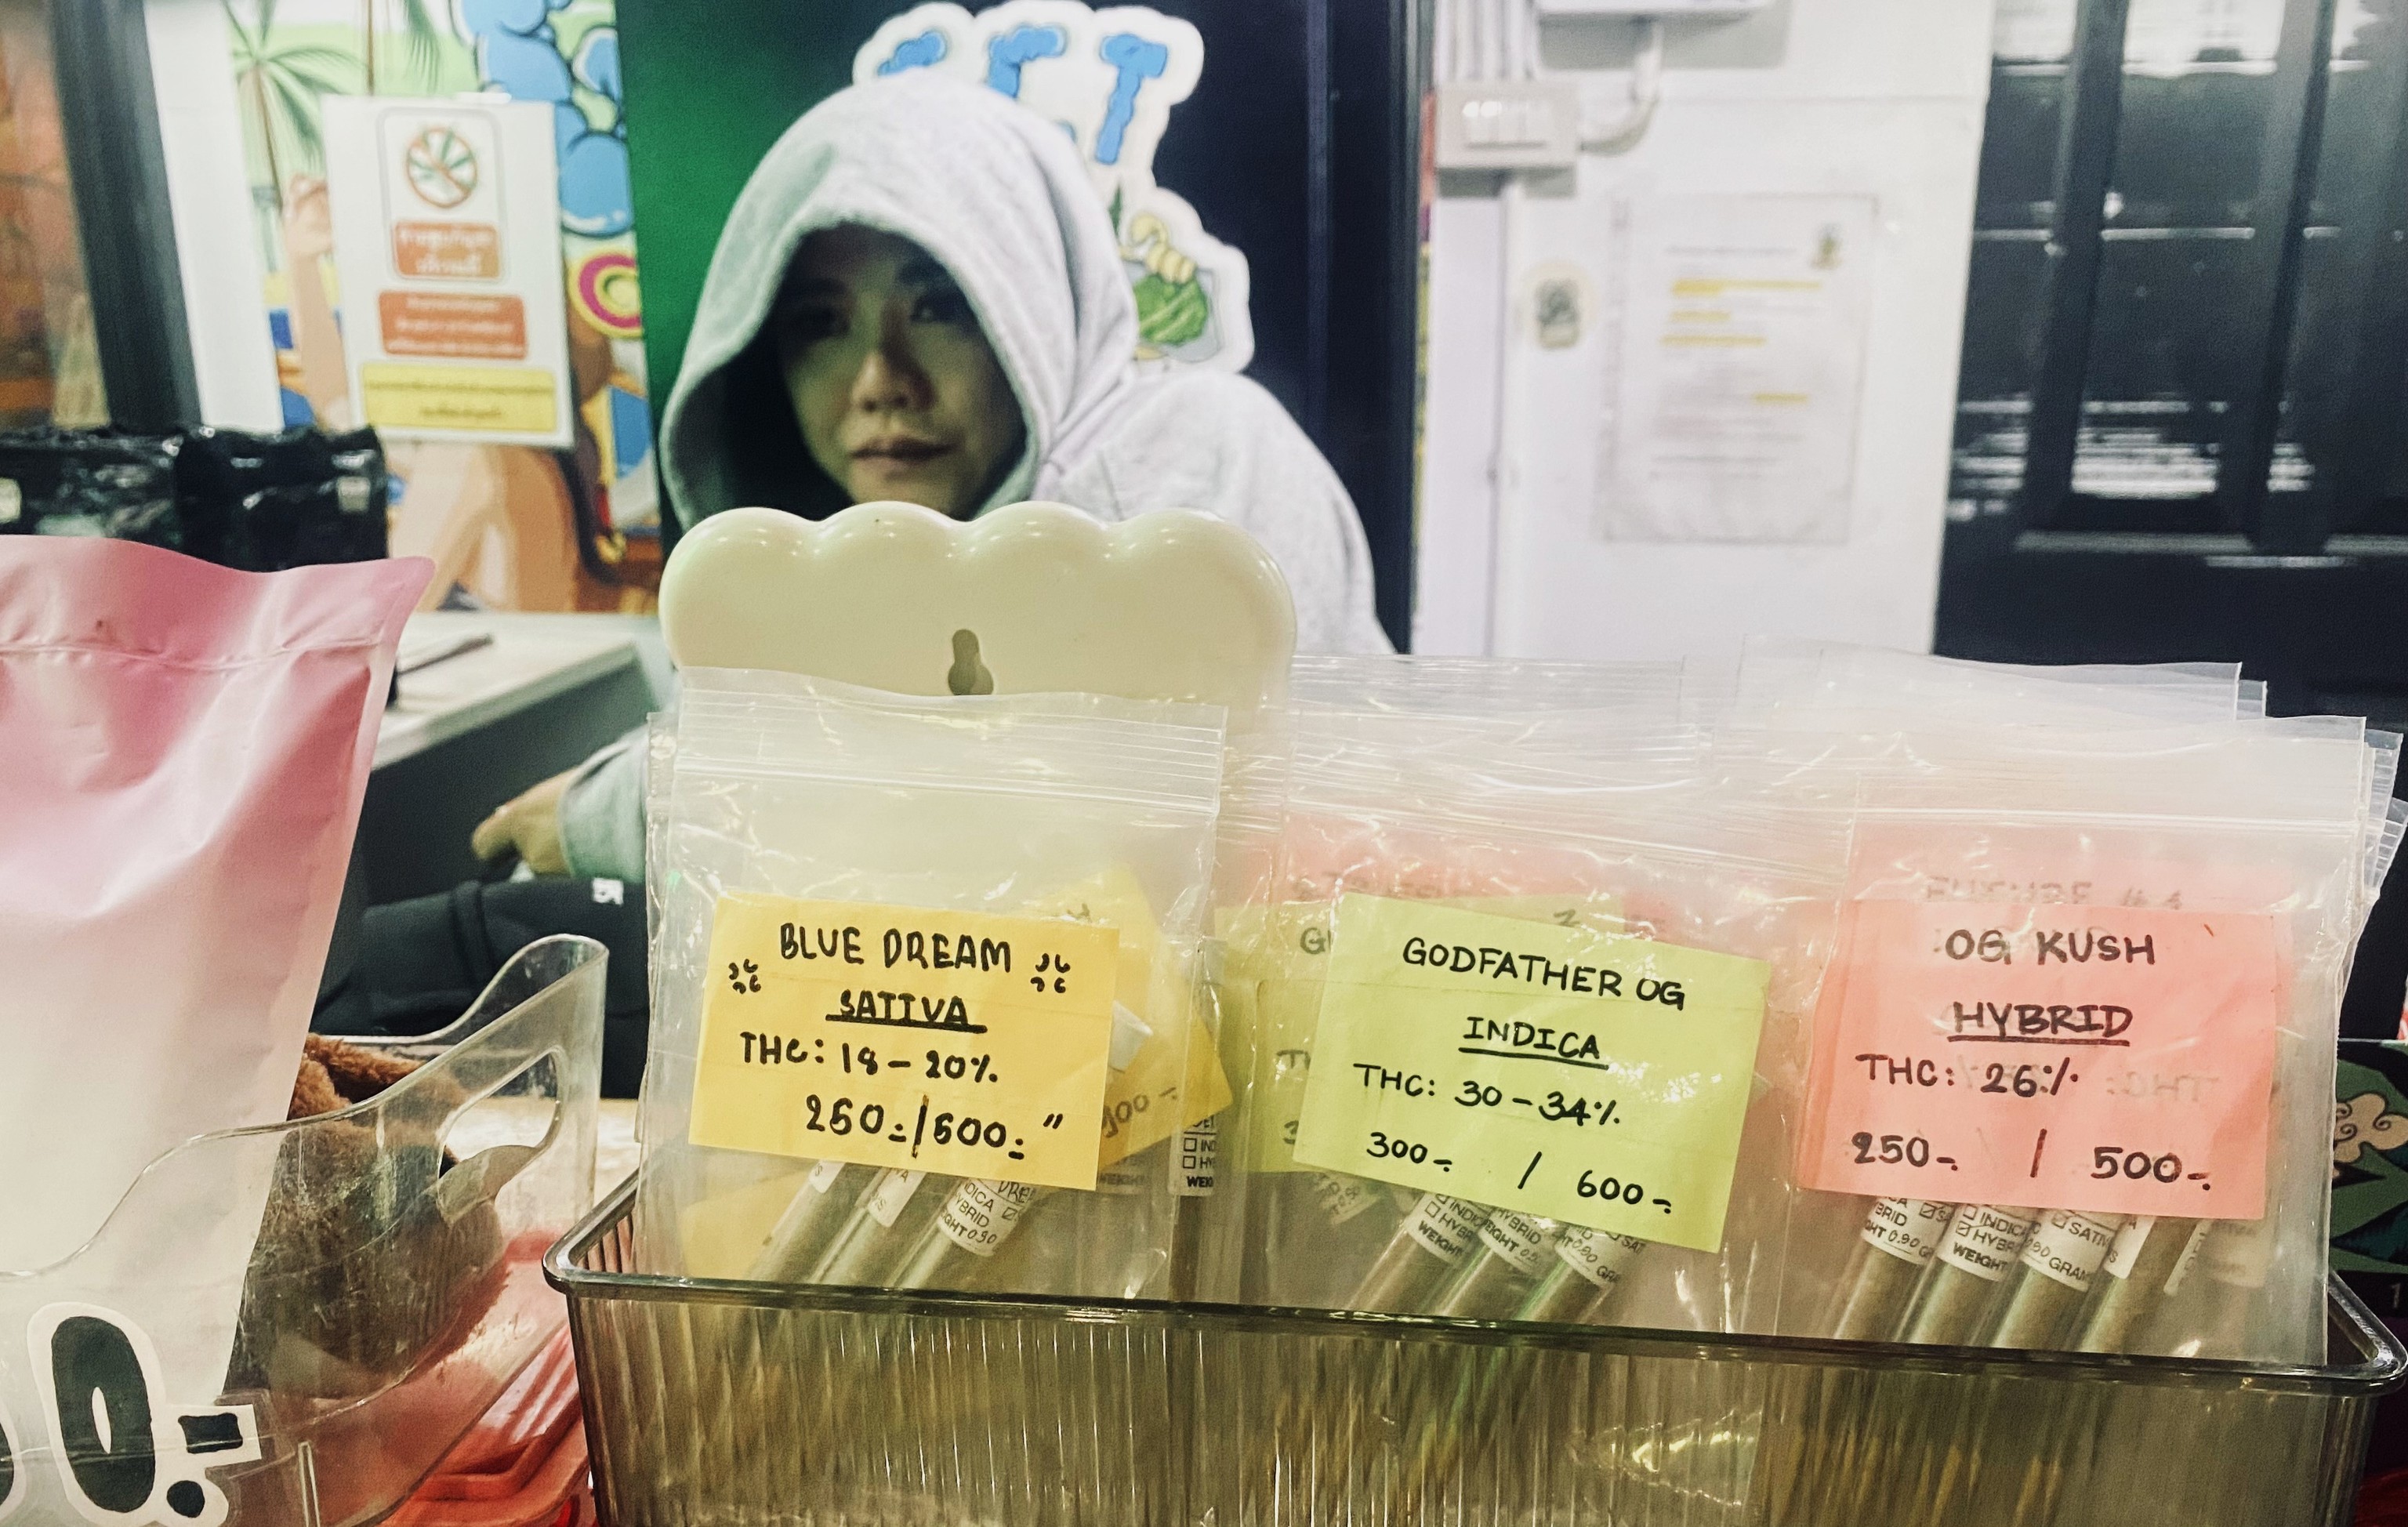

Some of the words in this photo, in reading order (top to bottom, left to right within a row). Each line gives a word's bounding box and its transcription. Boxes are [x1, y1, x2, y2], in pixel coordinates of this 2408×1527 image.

[781, 923, 864, 964] BLUE
[883, 928, 1011, 973] DREAM
[1945, 930, 2011, 965] OG
[2036, 930, 2155, 965] KUSH
[1402, 937, 1622, 998] GODFATHER
[1636, 977, 1685, 1011] OG
[1953, 1001, 2133, 1039] HYBRID
[740, 1032, 825, 1064] THC:
[1463, 1017, 1601, 1060] INDICA
[1353, 1063, 1436, 1097] THC:
[1855, 1053, 1956, 1088] THC:
[955, 1192, 990, 1228] YBRID
[964, 1181, 995, 1213] DICA
[1875, 1202, 1908, 1227] BRID
